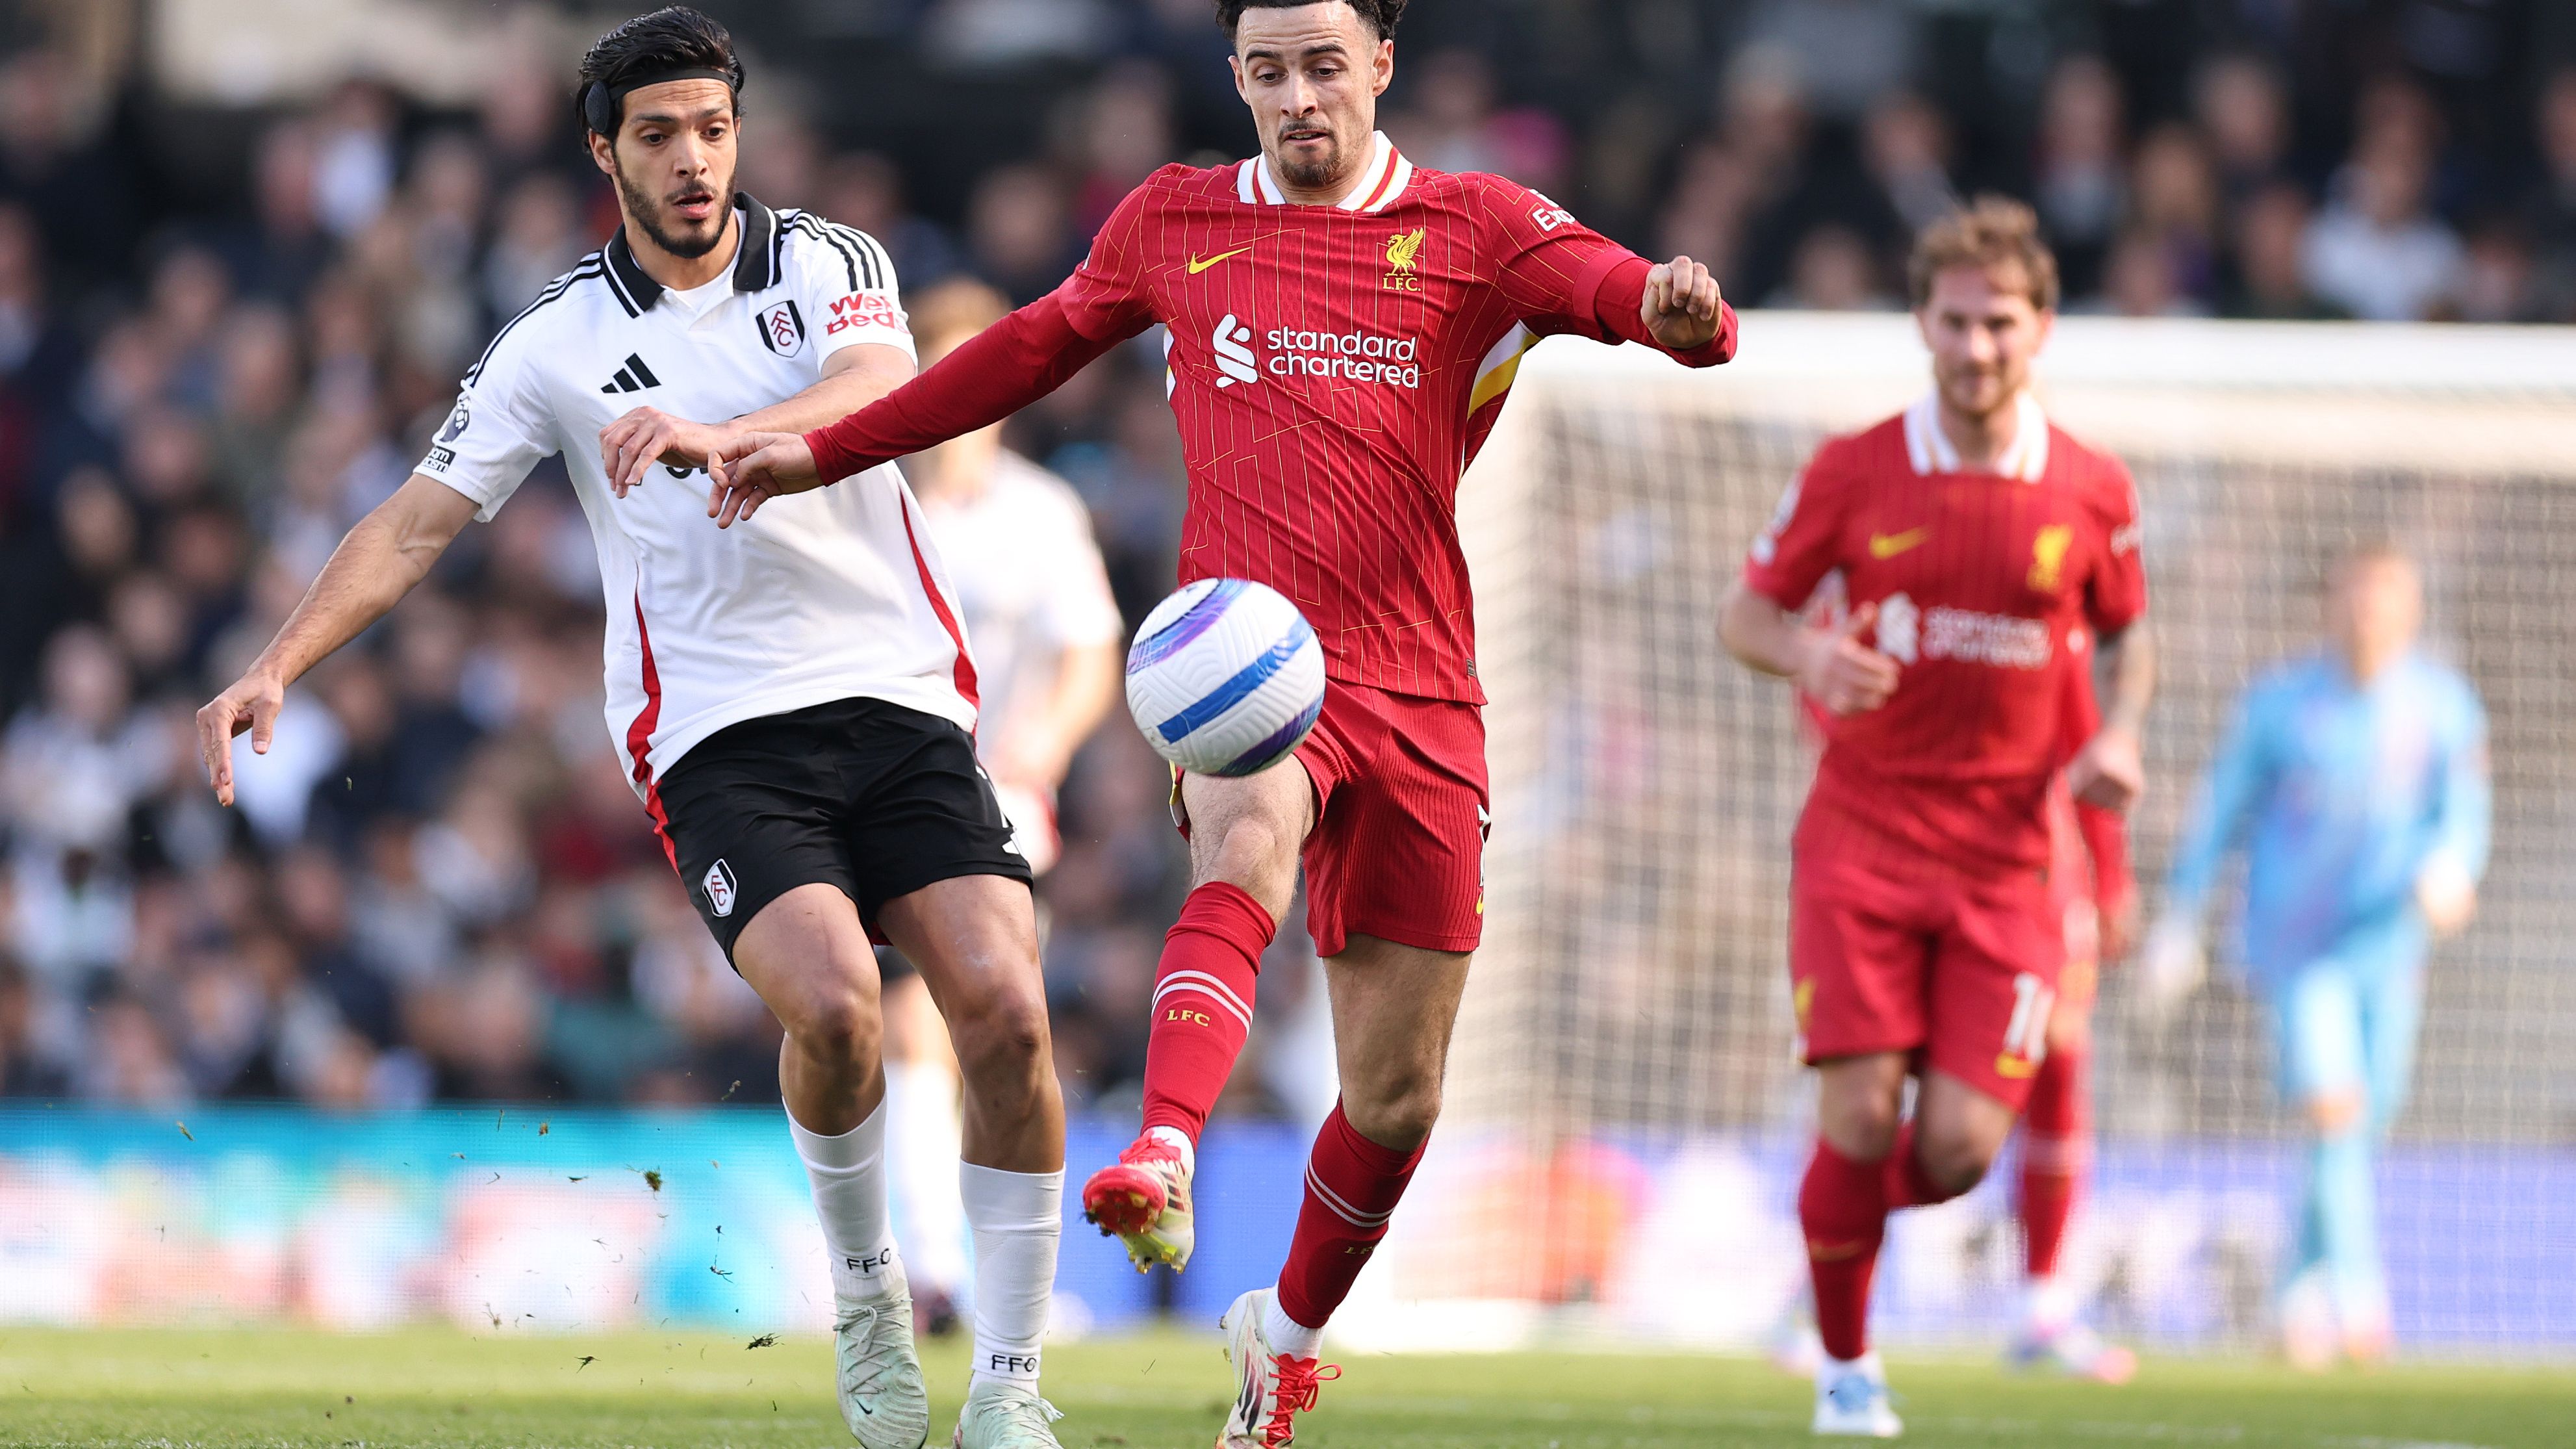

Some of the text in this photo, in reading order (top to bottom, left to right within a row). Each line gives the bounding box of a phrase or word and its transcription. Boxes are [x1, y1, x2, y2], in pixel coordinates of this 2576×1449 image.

[771, 311, 795, 347] FFC
[1268, 326, 1416, 361] standard
[1269, 351, 1419, 389] chartered
[711, 875, 728, 906] FFC
[1167, 1009, 1210, 1027] LFC
[847, 1248, 891, 1273] FFC
[1344, 1244, 1377, 1254] LF
[991, 1354, 1037, 1372] FFC
